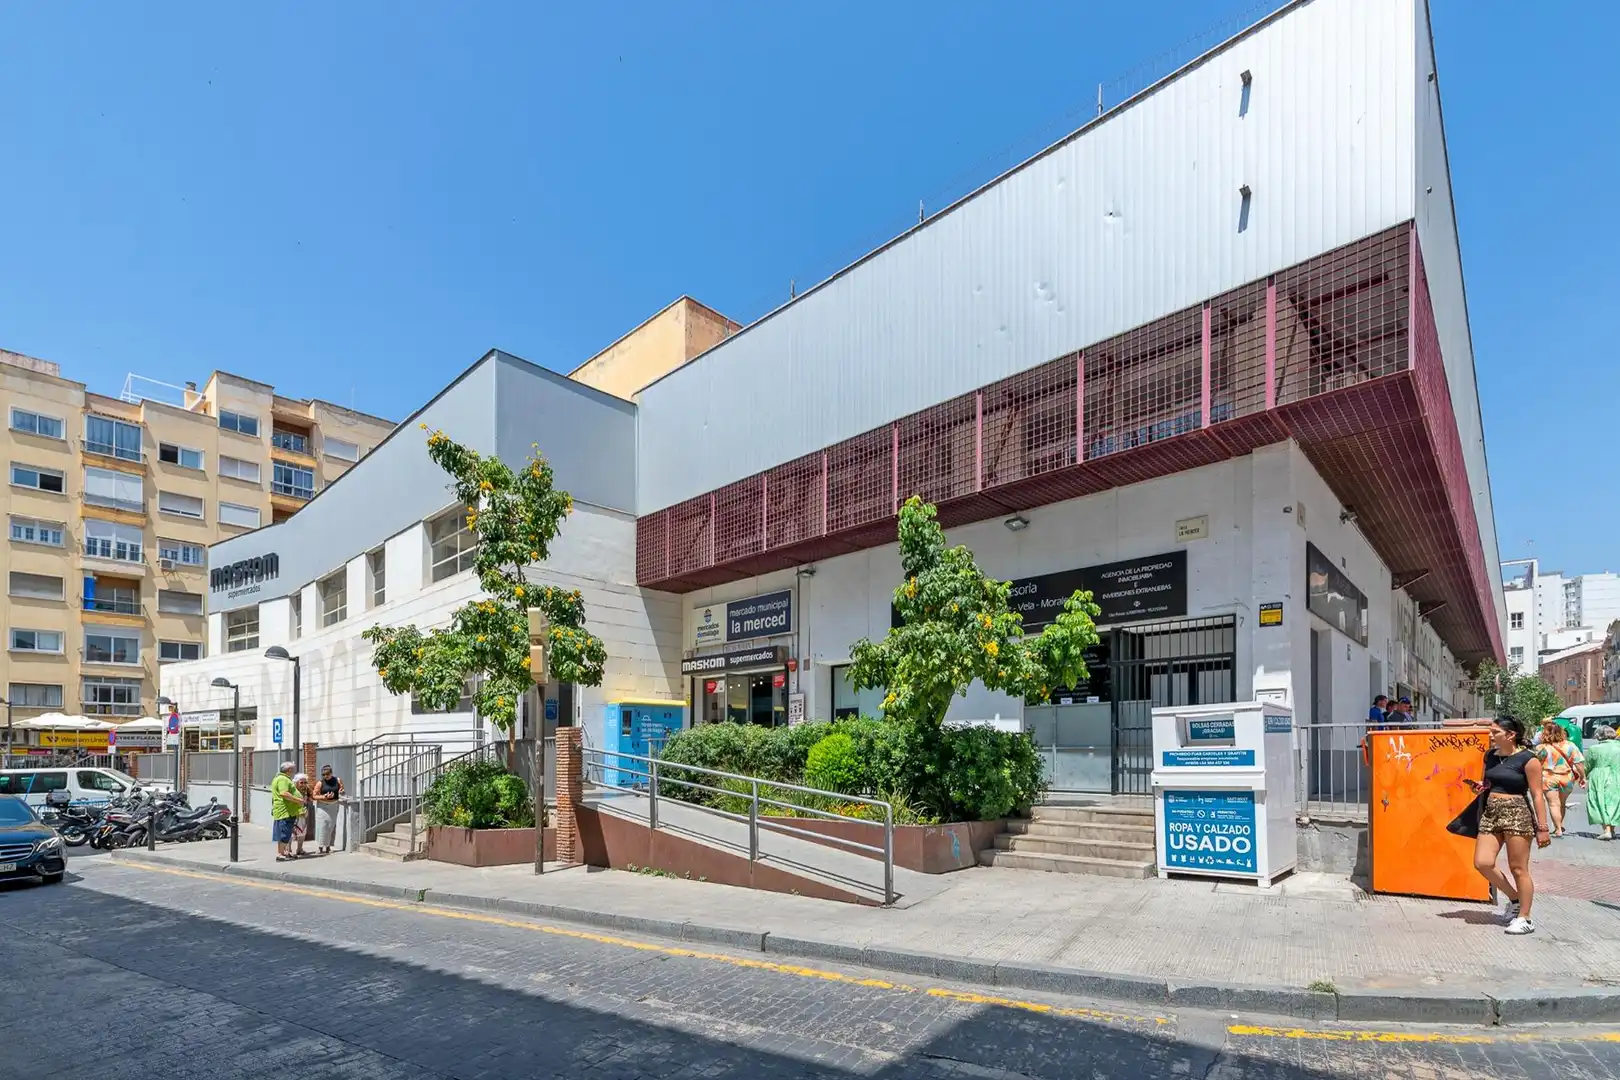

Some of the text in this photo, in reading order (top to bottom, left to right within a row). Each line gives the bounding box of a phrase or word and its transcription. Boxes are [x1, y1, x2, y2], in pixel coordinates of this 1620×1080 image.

[210, 552, 279, 592] MASKOM
[1101, 571, 1125, 579] AGENCIA
[1141, 562, 1172, 572] PROPIEDAD
[1118, 573, 1153, 583] INMOBILIARIA
[228, 585, 260, 599] supermercados
[1009, 583, 1038, 597] esoría
[1102, 584, 1172, 600] INVERSIONES EXTRANJERAS
[730, 598, 789, 617] mercado municipal
[1017, 602, 1035, 611] Vela
[1041, 597, 1068, 608] Morale
[731, 611, 786, 634] la merced
[682, 657, 725, 672] MASKOM
[729, 650, 773, 665] supermercados
[1169, 823, 1251, 835] ROPA Y CALZADO
[1169, 833, 1251, 854] USADO
